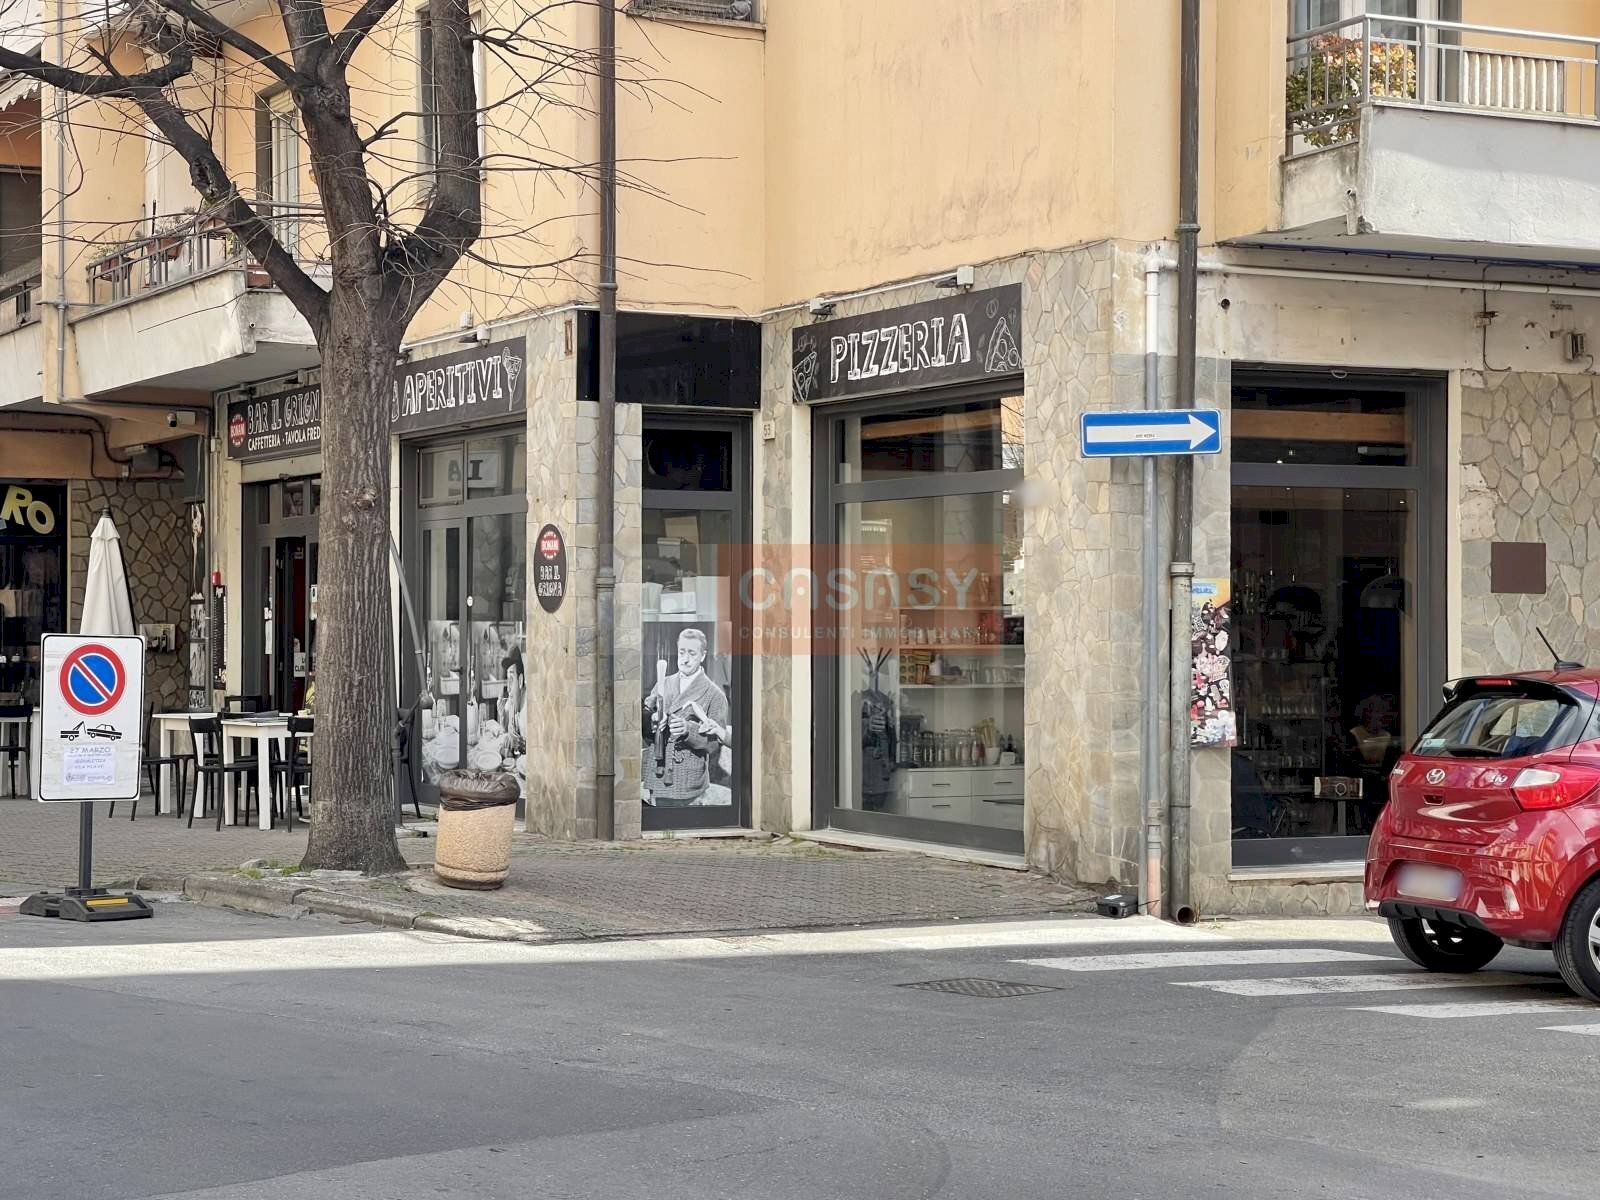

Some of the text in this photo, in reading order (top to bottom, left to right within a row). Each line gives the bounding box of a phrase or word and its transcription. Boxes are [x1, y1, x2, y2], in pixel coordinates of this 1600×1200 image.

[830, 313, 971, 384] PIZZERIA
[247, 401, 269, 435] BAR
[284, 389, 321, 427] GRIGN
[402, 354, 503, 417] APERITIVI
[247, 434, 281, 451] CAFFETTERIA
[284, 429, 307, 445] TAVOLA
